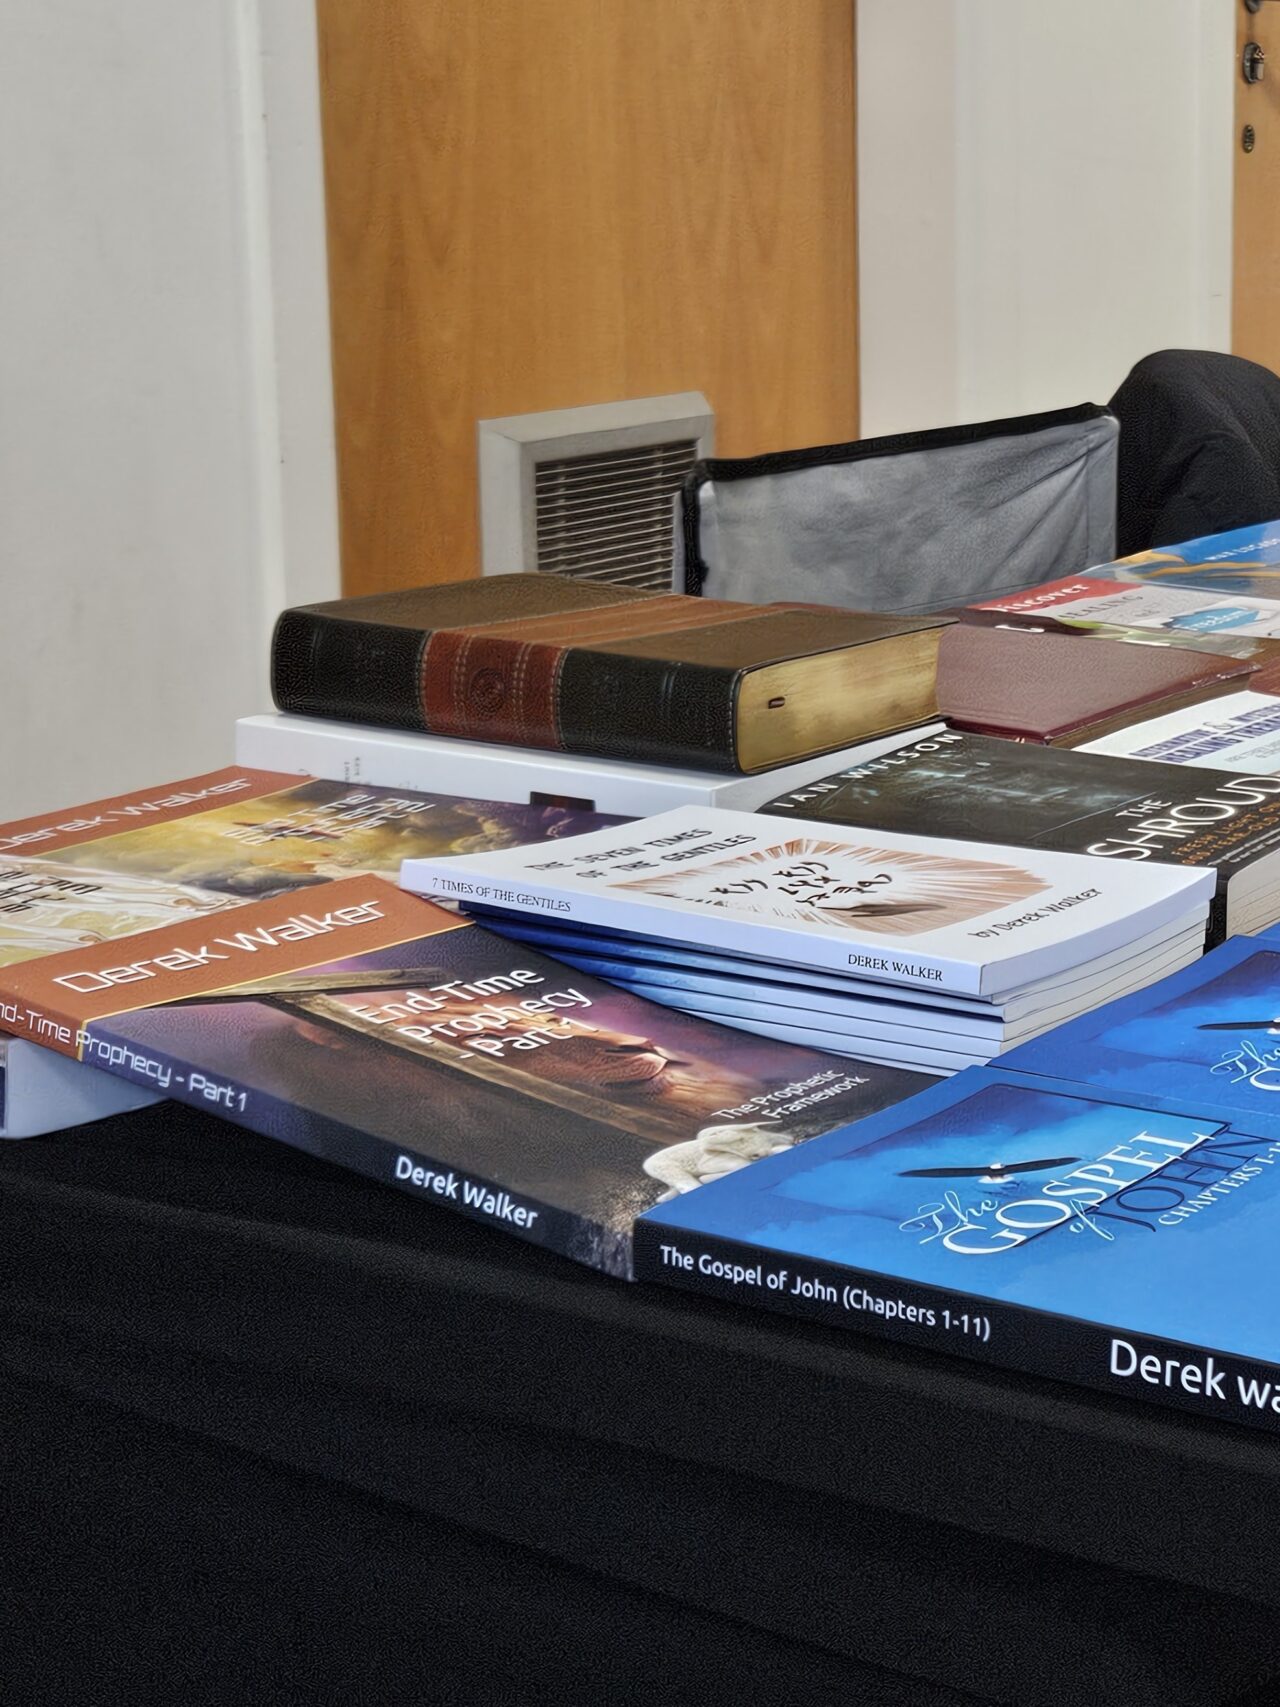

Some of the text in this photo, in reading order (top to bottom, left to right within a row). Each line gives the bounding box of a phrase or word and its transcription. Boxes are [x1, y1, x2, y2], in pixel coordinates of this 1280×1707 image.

[774, 734, 963, 808] IAN WILSON
[1151, 736, 1245, 763] HEALING
[108, 778, 251, 816] Walker
[1115, 799, 1172, 818] THE
[525, 828, 713, 872] THE SEVEN TIMES
[575, 834, 757, 879] OF THE GENTILES
[1171, 832, 1219, 857] FRESH
[1216, 814, 1260, 836] LIGHT
[432, 877, 571, 912] 7 TIMES OF THE GENTILES
[52, 900, 385, 993] Derek Walker
[967, 928, 1000, 939] by
[848, 953, 943, 982] DEREK WALKER
[349, 969, 546, 1024] End-Time
[396, 987, 594, 1044] Prophecy
[0, 1002, 71, 1045] nd-Time
[75, 1031, 171, 1088] Prophecy
[189, 1073, 235, 1108] Part
[237, 1091, 248, 1112] 1
[466, 1026, 574, 1057] Part
[559, 1017, 599, 1032] 1
[711, 1069, 846, 1120] The Prophetic
[761, 1075, 871, 1119] Framework
[394, 1155, 539, 1229] Derek Walker
[942, 1129, 1217, 1255] GOSPEL
[1157, 1165, 1264, 1227] CHAPTERS
[899, 1190, 999, 1245] The
[1069, 1198, 1115, 1241] of
[660, 1244, 992, 1342] The Gospel of John (Chapters 1-11)
[1109, 1338, 1227, 1401] Derek
